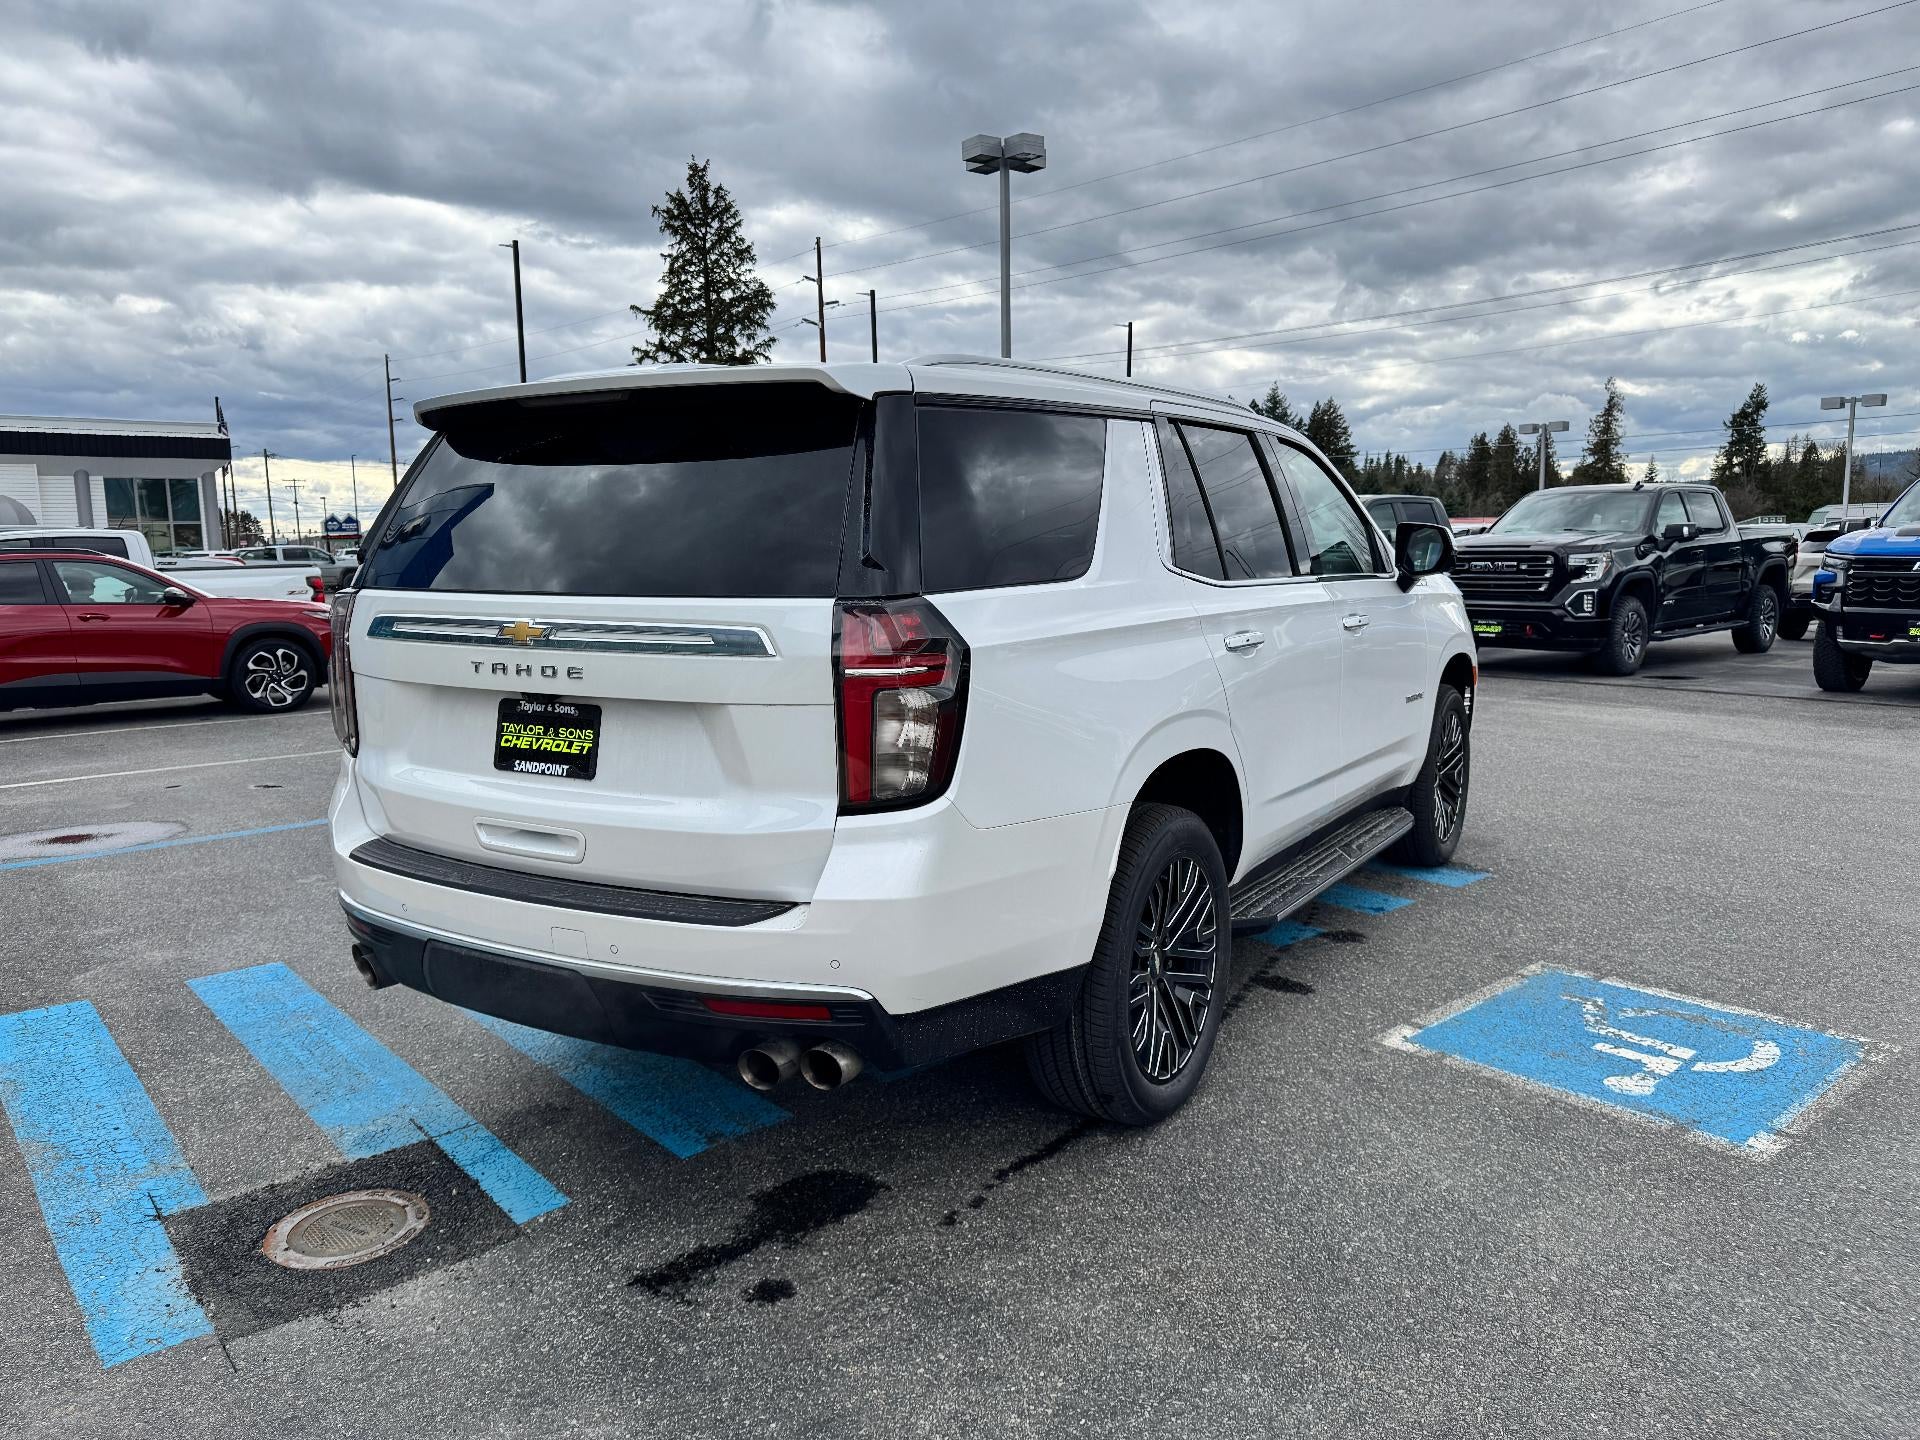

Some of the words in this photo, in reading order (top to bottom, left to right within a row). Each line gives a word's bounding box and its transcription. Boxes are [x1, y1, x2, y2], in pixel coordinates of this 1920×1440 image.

[1470, 562, 1518, 571] GMC
[471, 661, 584, 679] TAHOE
[520, 701, 545, 713] Taylor
[554, 703, 576, 714] Sons
[502, 722, 544, 736] TAYLOR
[546, 727, 555, 738] &
[558, 727, 594, 740] SONS
[501, 735, 593, 755] CHEVROLET
[513, 760, 570, 777] SANDPOINT
